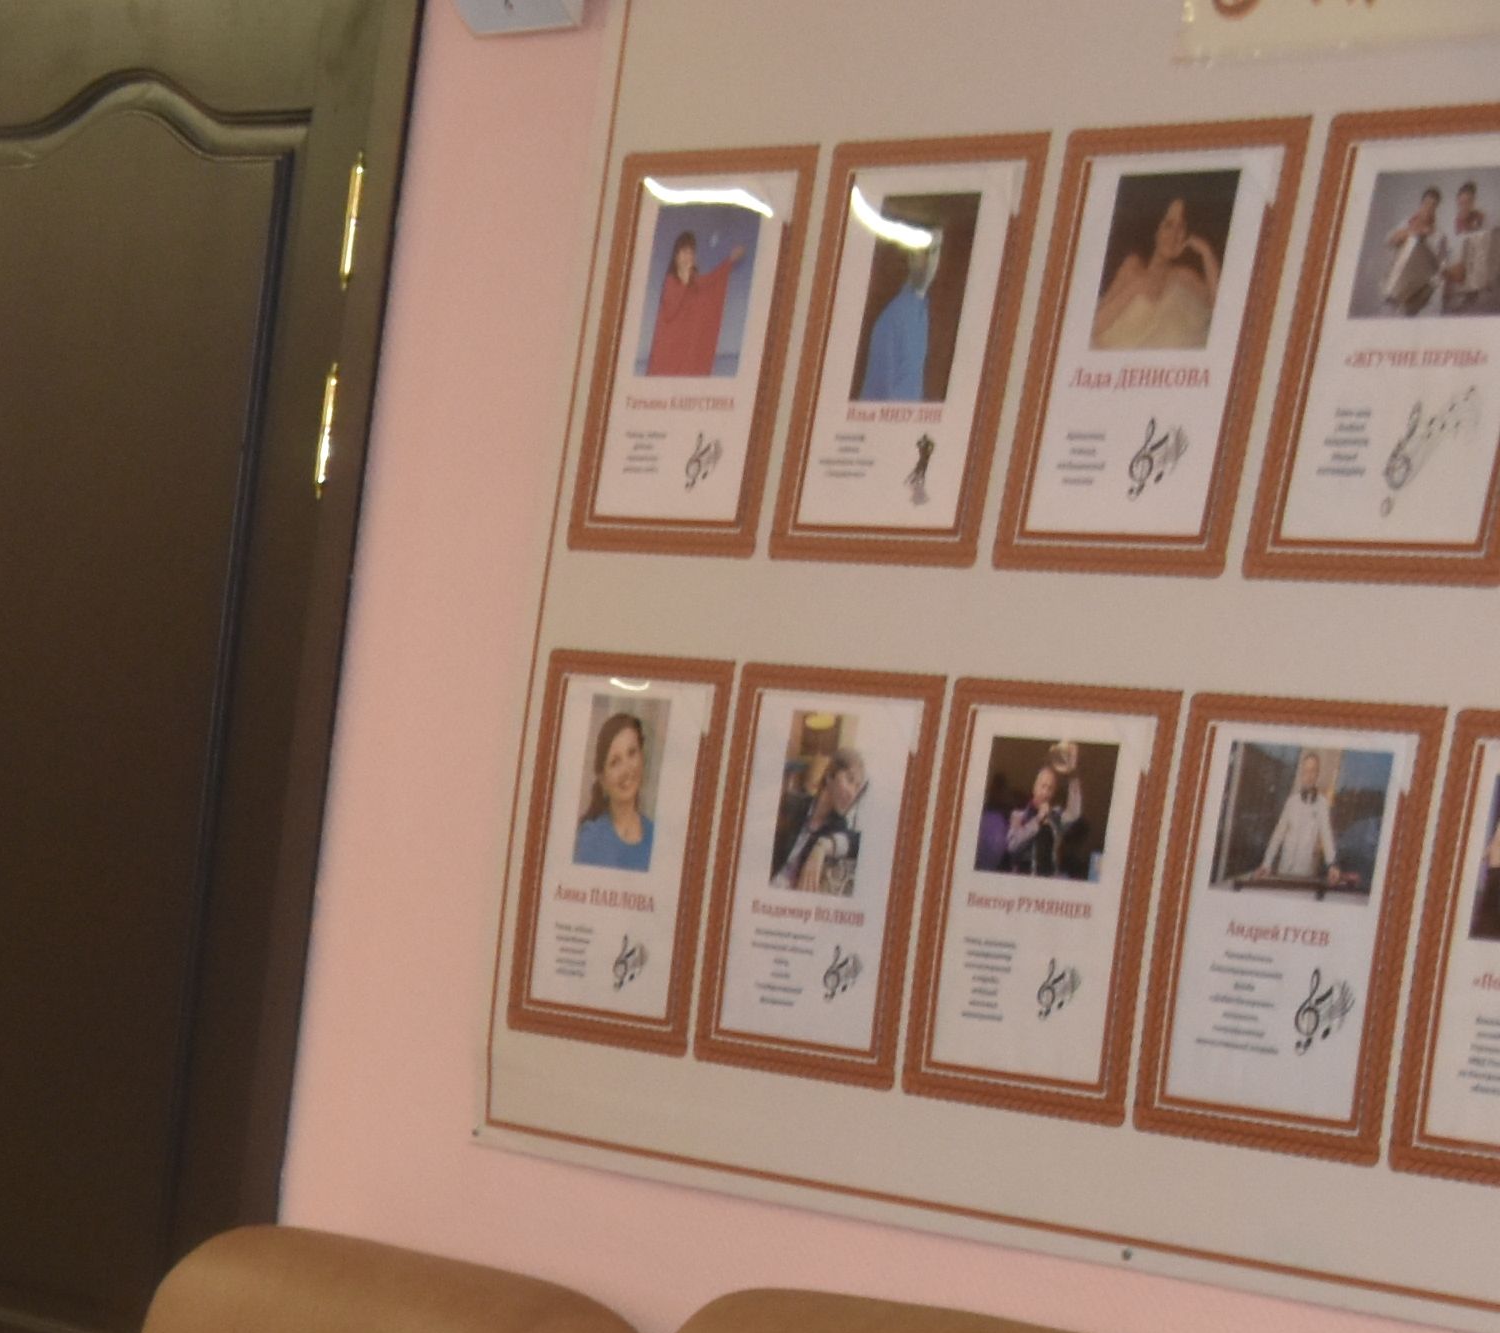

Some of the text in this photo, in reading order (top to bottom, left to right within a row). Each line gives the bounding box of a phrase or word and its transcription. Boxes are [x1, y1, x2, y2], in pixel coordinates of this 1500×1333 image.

[1068, 367, 1211, 390] Лада ДЕНИСОВА
[589, 888, 655, 912] ПАВЛОВА
[1227, 920, 1280, 943] Андрей
